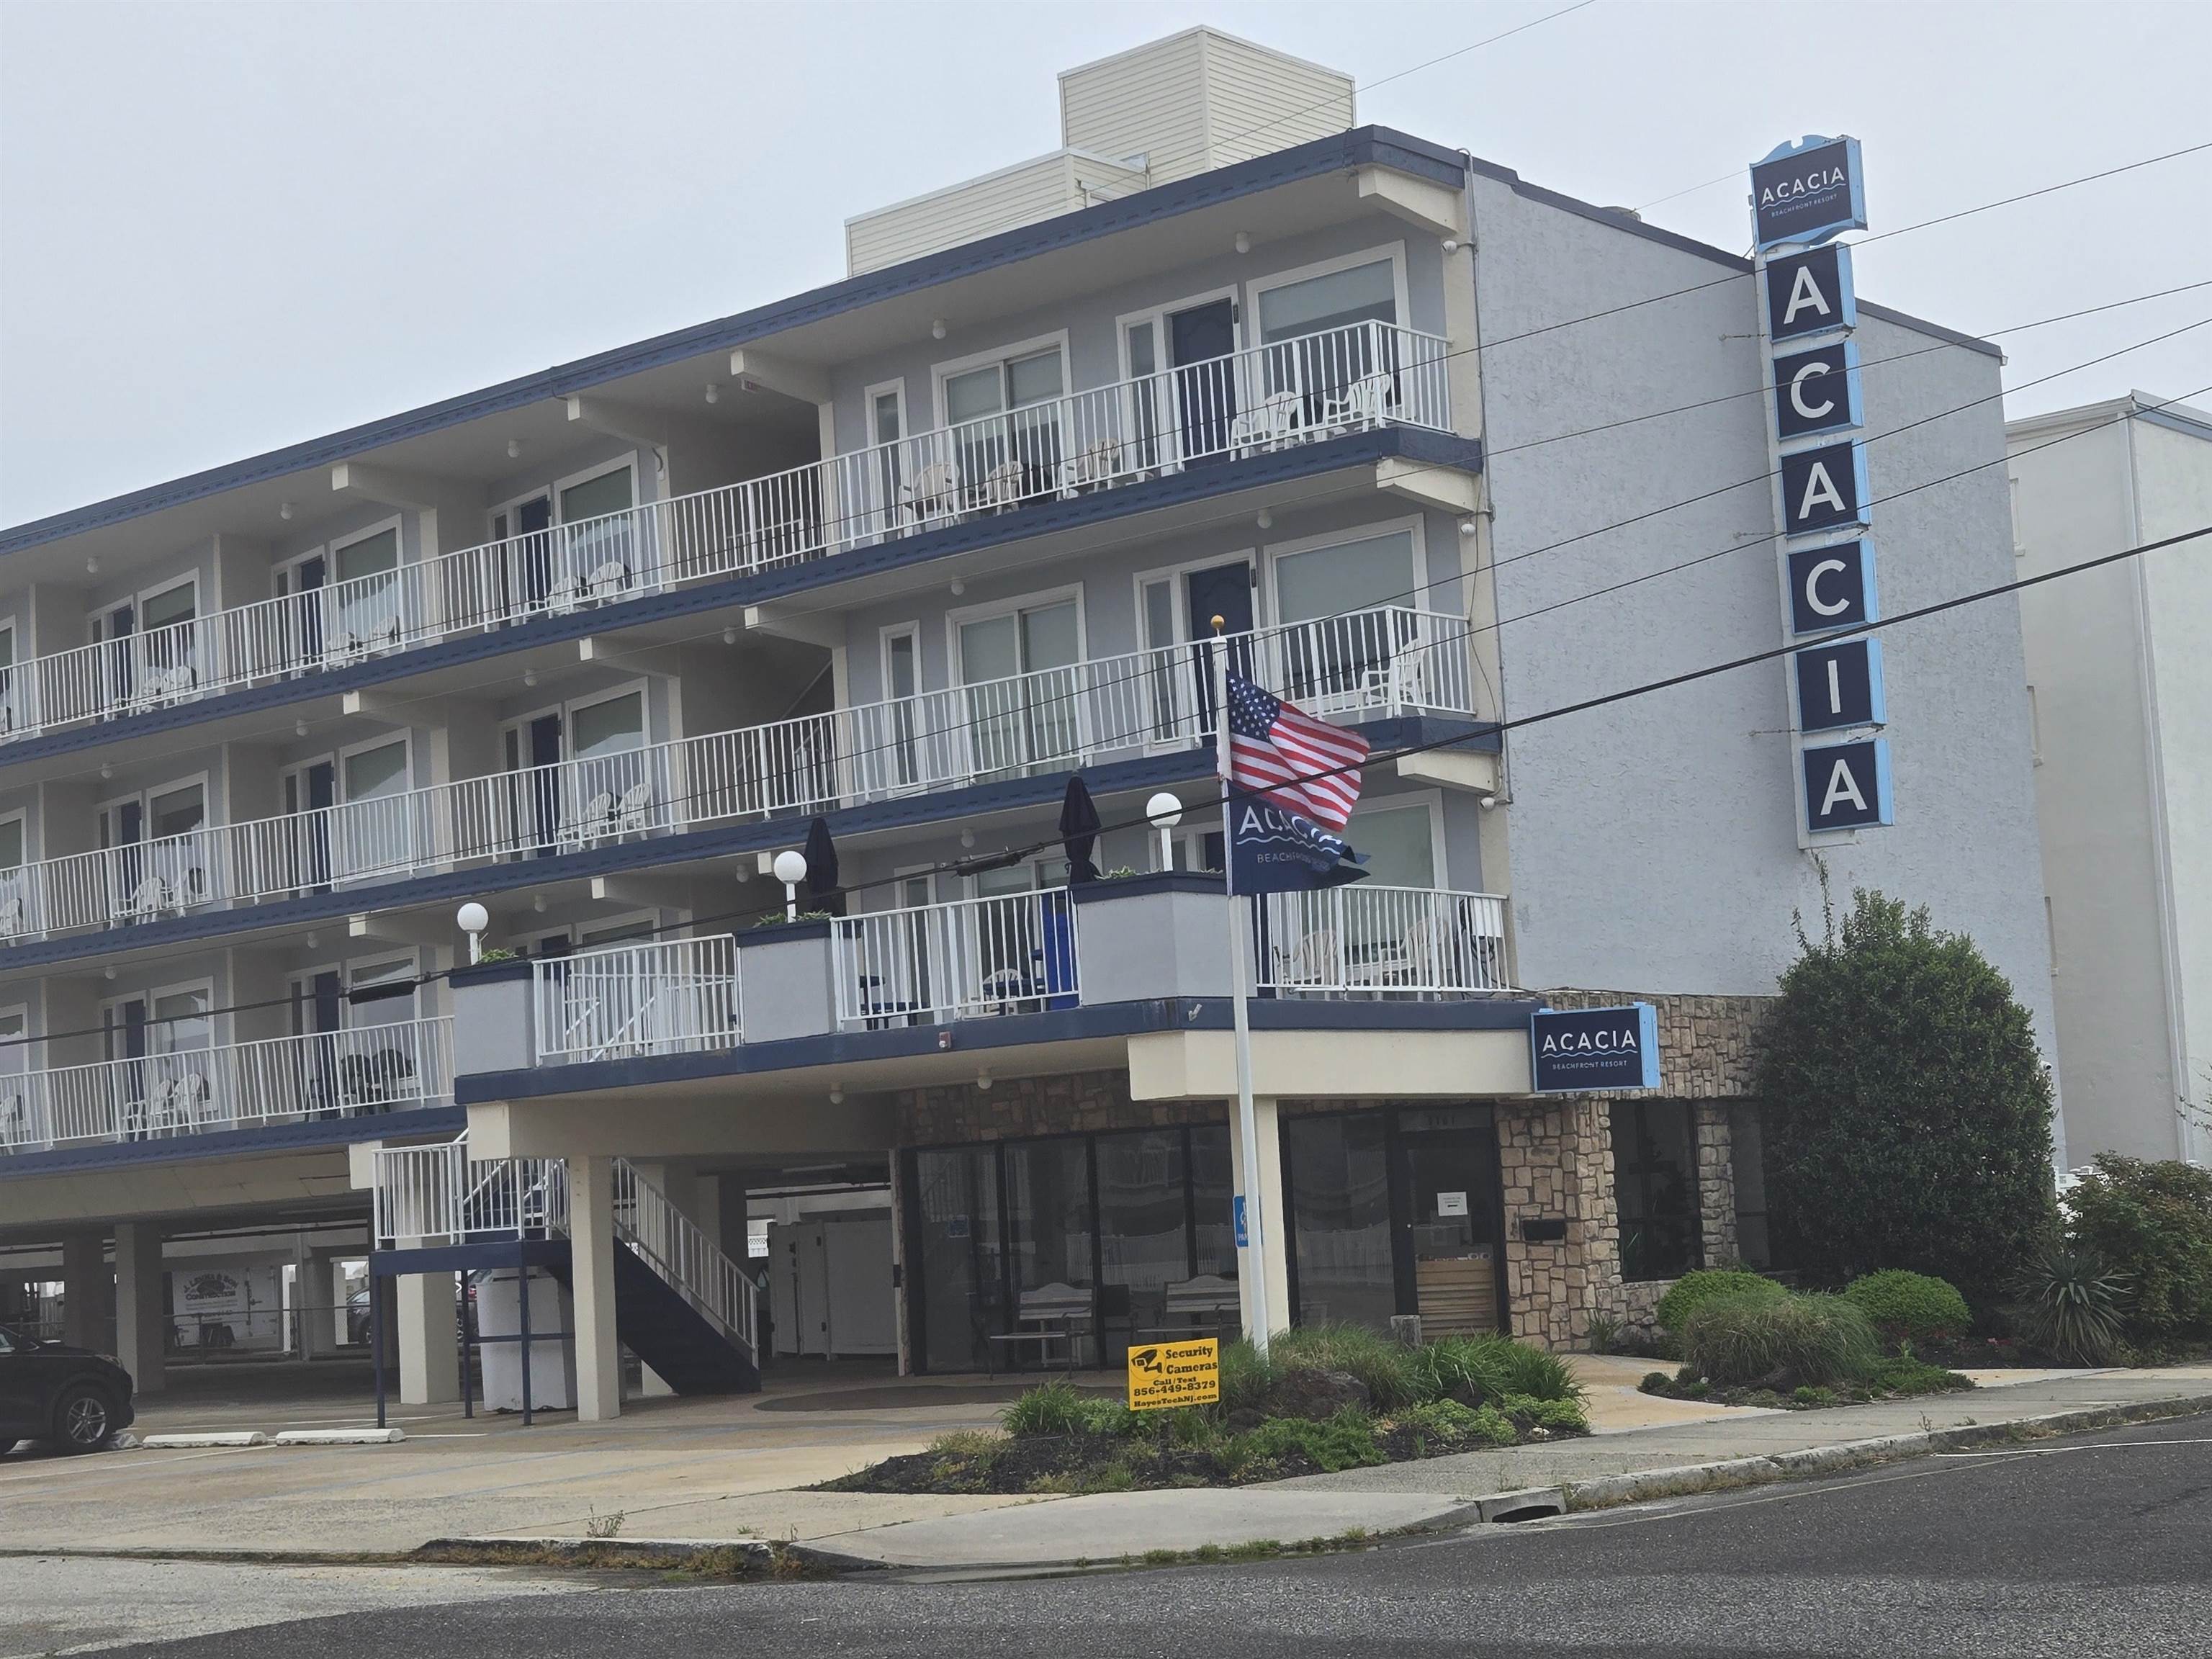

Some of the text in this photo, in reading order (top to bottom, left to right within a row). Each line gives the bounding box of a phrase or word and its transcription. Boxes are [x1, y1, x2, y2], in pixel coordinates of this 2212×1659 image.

[1761, 166, 1845, 204] ACACIA
[1771, 193, 1838, 218] BEACHFRONT RESORT
[1784, 266, 1868, 816] ACACIA
[1542, 1029, 1637, 1052] ACACIA
[1552, 1059, 1627, 1070] BEACHFRONT RESORT
[1166, 1346, 1213, 1359] Security
[1166, 1362, 1218, 1375] Cameras
[1134, 1380, 1216, 1396] 856-449-8379
